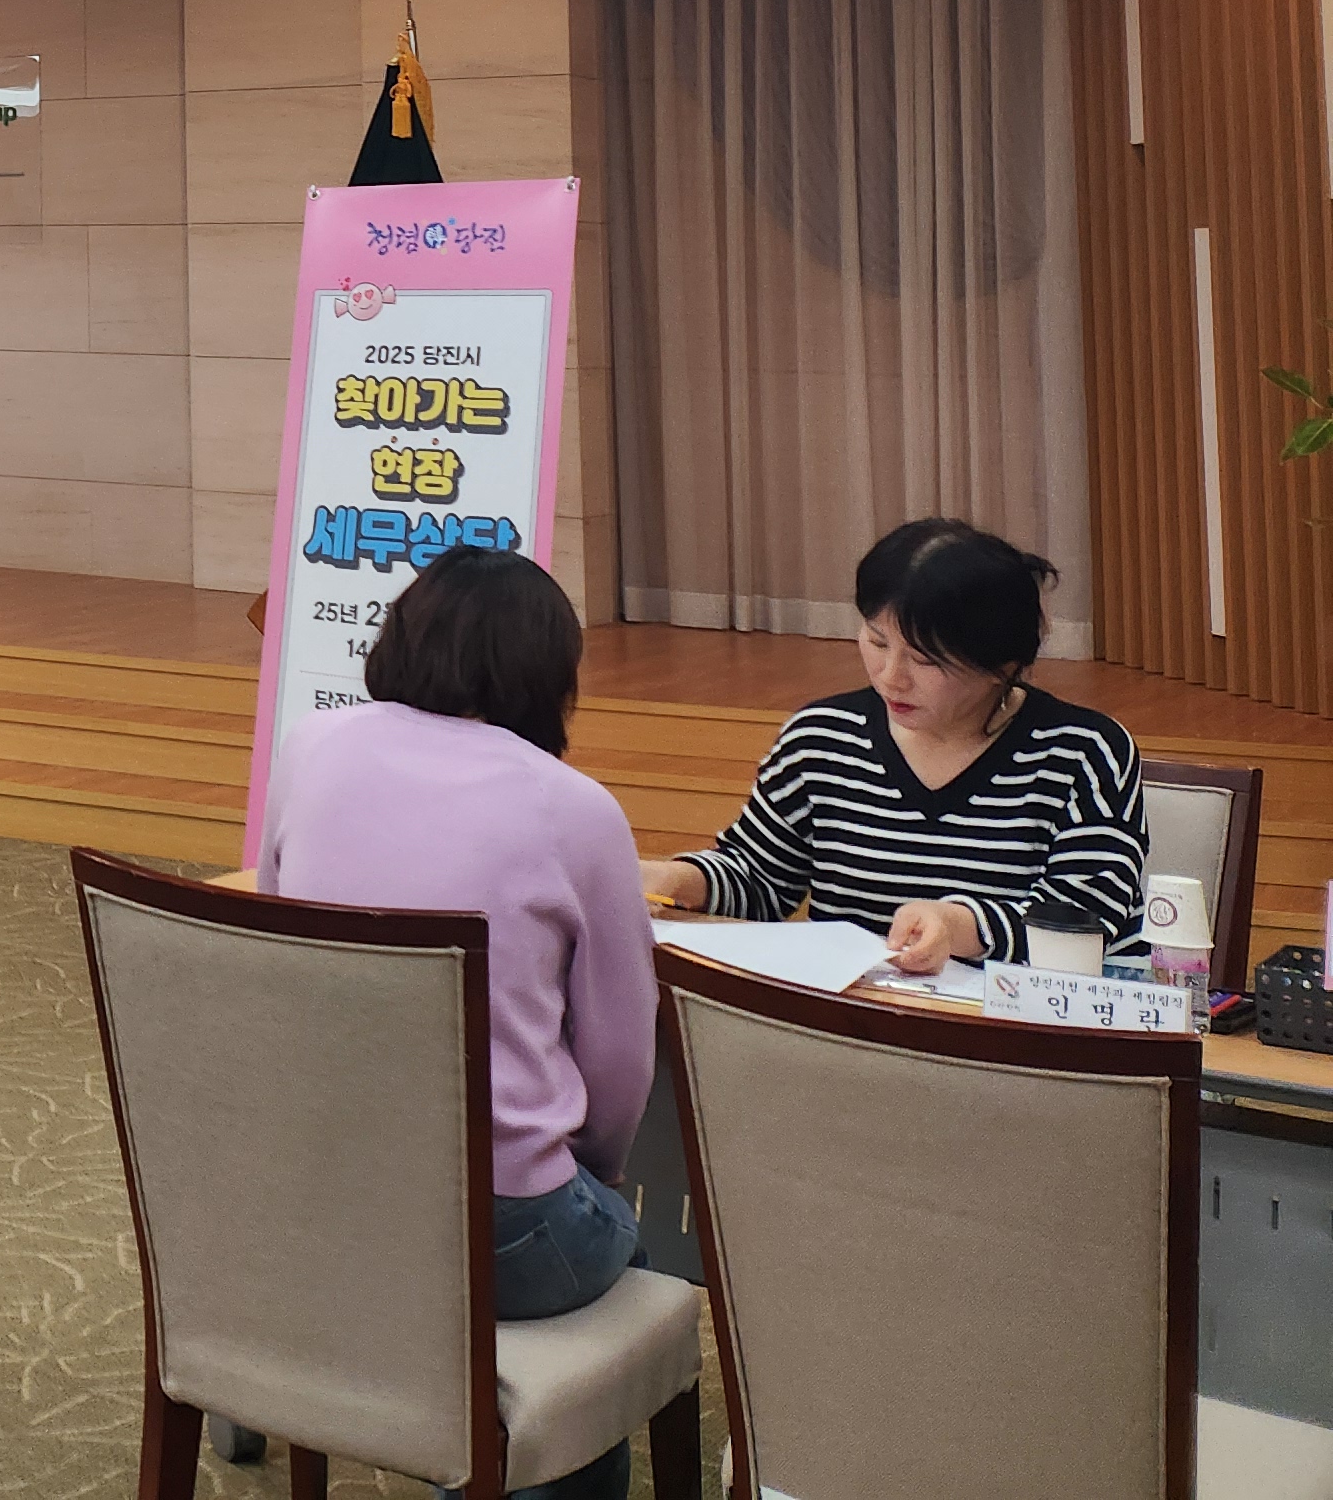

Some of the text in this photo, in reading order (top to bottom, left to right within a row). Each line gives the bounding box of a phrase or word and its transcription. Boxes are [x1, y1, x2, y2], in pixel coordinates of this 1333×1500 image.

[367, 222, 506, 255] 청렴 당진
[364, 345, 482, 367] 2025 당진시
[335, 373, 510, 434] 찾아가는
[371, 445, 464, 503] 현장
[312, 600, 389, 627] 25년 2
[347, 639, 370, 660] 14
